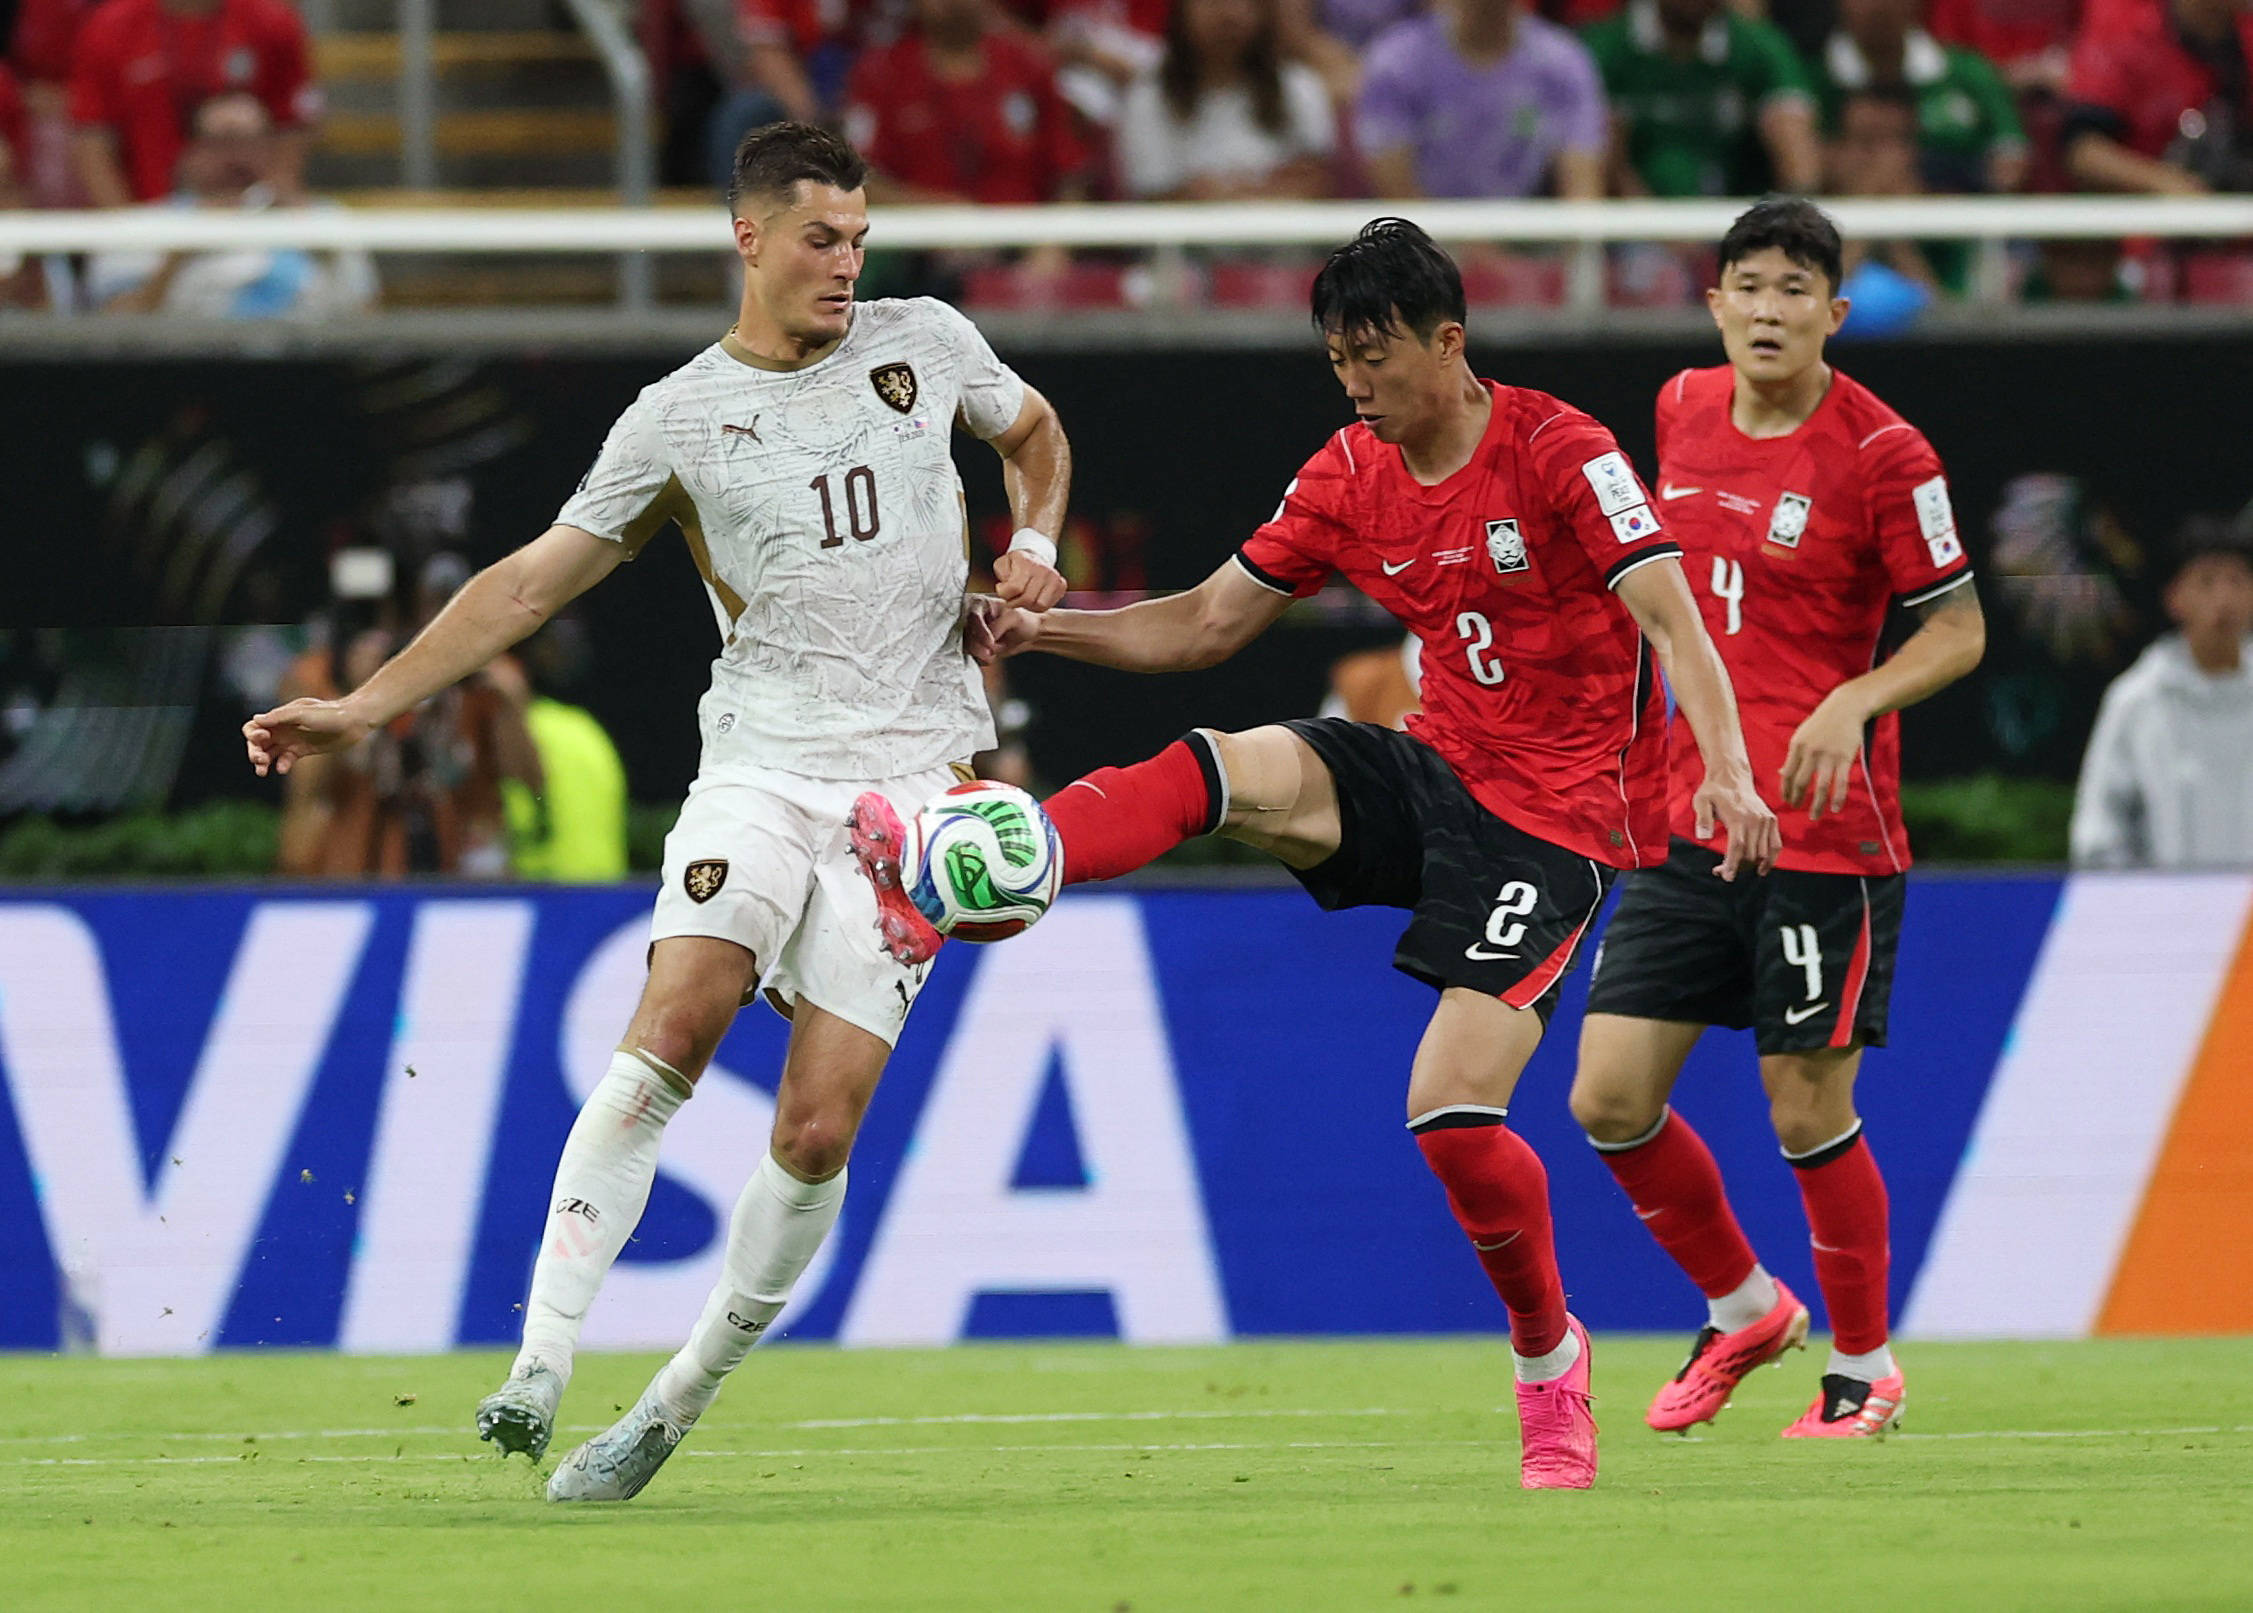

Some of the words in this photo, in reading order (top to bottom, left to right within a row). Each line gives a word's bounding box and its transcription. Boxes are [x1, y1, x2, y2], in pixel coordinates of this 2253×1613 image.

[809, 464, 881, 550] 10
[1711, 555, 1745, 636] 4
[1456, 611, 1505, 685] 2
[1484, 880, 1539, 947] 2
[1779, 923, 1823, 1002] 4
[556, 1197, 600, 1223] CZE
[727, 1311, 769, 1333] CZE
